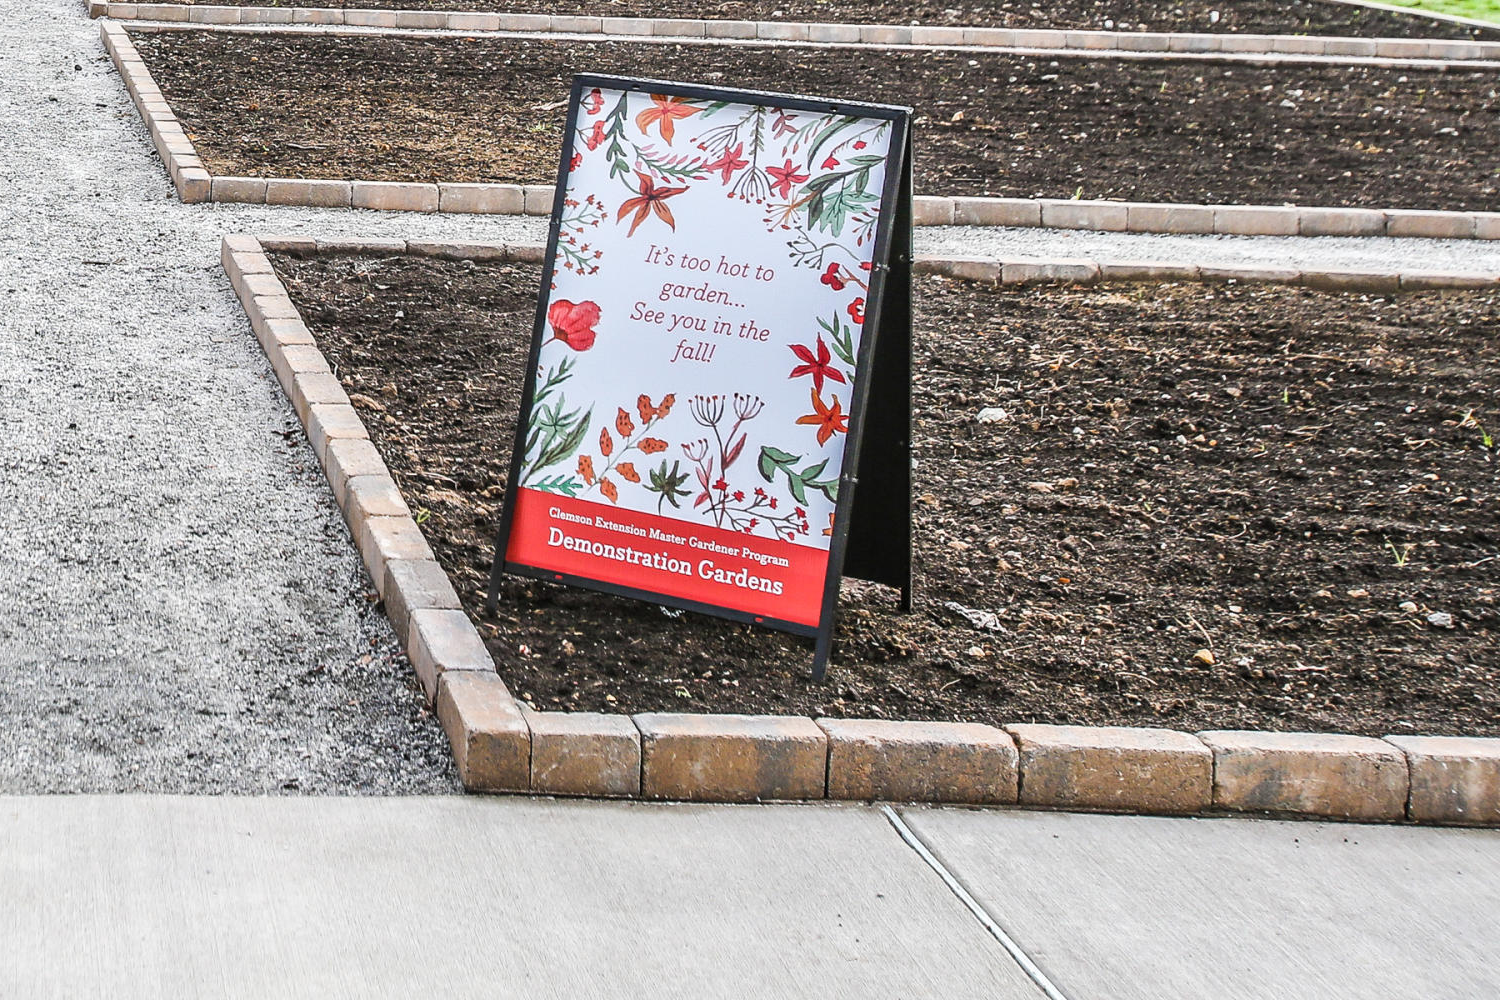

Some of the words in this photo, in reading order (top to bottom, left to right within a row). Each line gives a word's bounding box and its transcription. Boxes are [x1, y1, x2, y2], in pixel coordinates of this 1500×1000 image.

[644, 245, 675, 266] It's
[681, 254, 711, 272] too
[717, 256, 750, 278] hot
[756, 265, 775, 282] to
[659, 282, 746, 308] garden...
[630, 301, 664, 324] See
[667, 314, 706, 332] you
[713, 316, 732, 336] in
[738, 320, 770, 342] the
[670, 339, 716, 363] fall!
[549, 507, 593, 526] Clemson
[595, 517, 647, 537] Extension
[649, 527, 687, 546] Master
[689, 536, 740, 557] Gardener
[742, 547, 790, 567] Program
[548, 527, 692, 576] Demonstration
[698, 559, 784, 596] Gardens
